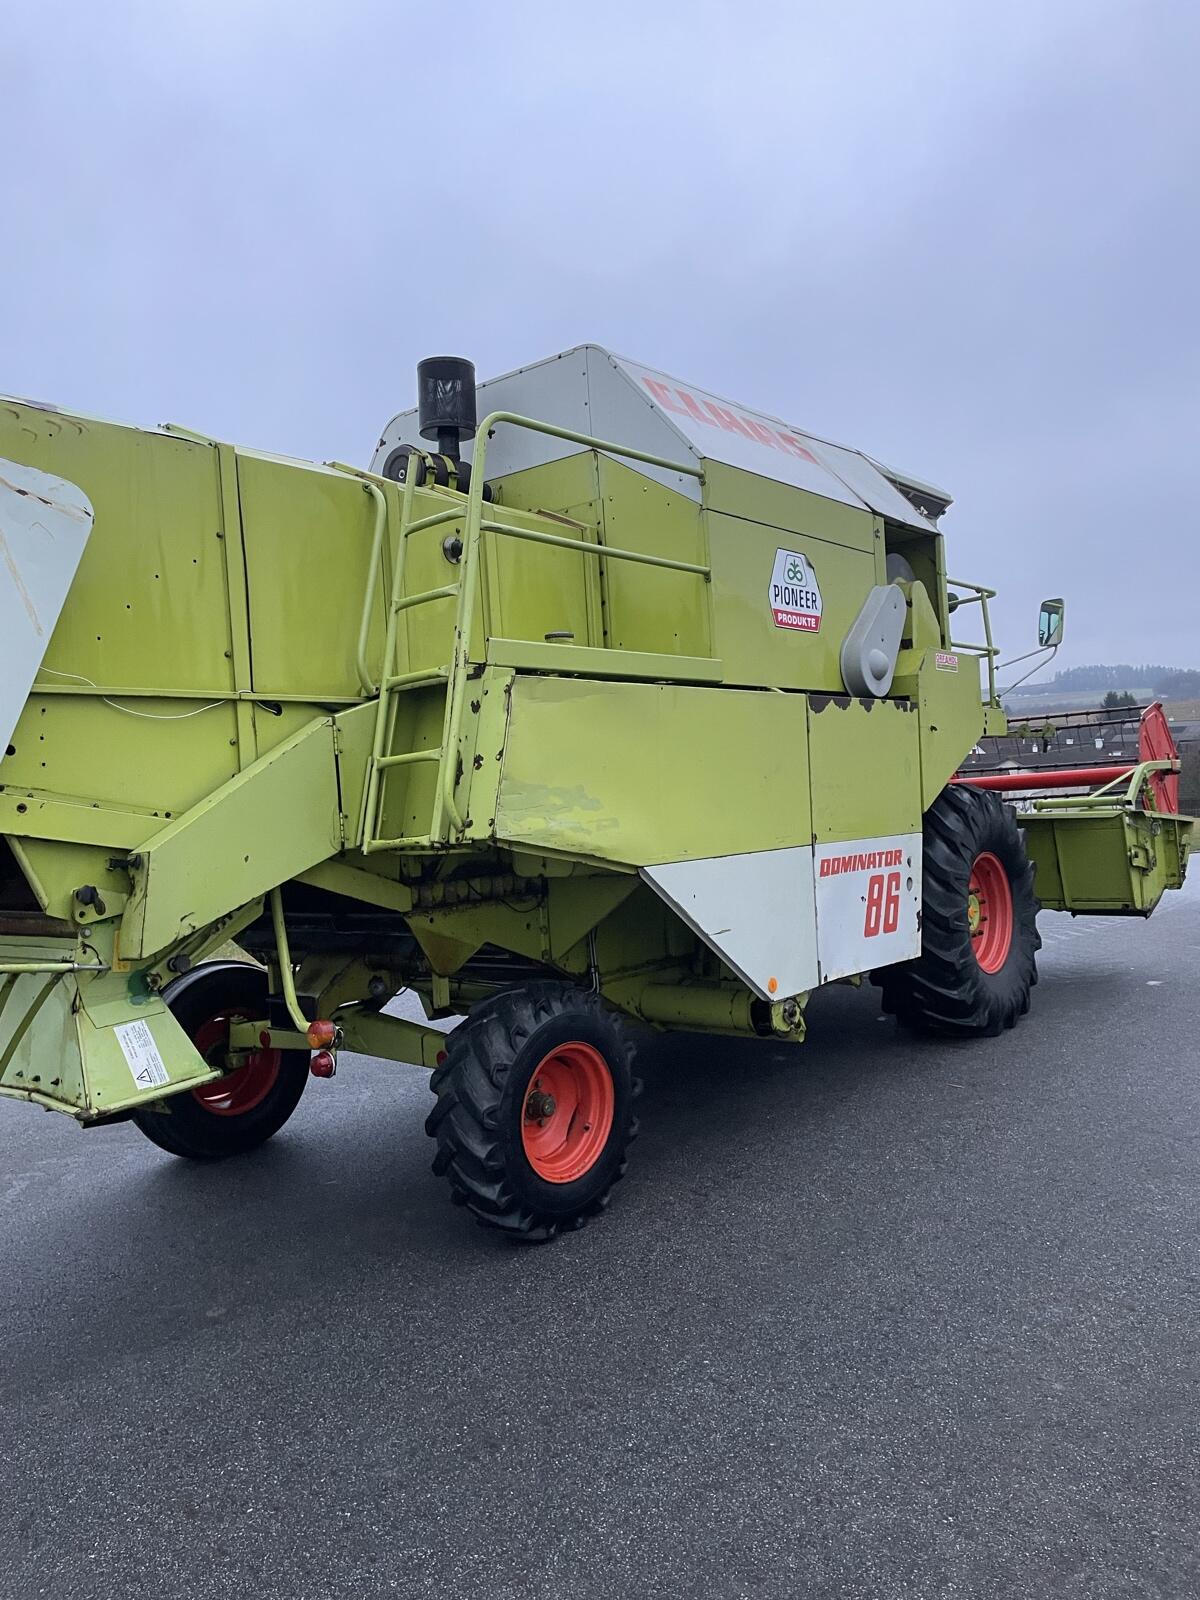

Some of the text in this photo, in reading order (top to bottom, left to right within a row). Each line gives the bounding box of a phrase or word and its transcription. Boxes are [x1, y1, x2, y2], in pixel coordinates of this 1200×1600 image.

[641, 376, 820, 465] CLAAS
[773, 584, 818, 610] PIONEER
[777, 612, 816, 628] PRODUKTE
[820, 849, 902, 877] DOMINATOR
[864, 871, 901, 938] 86
